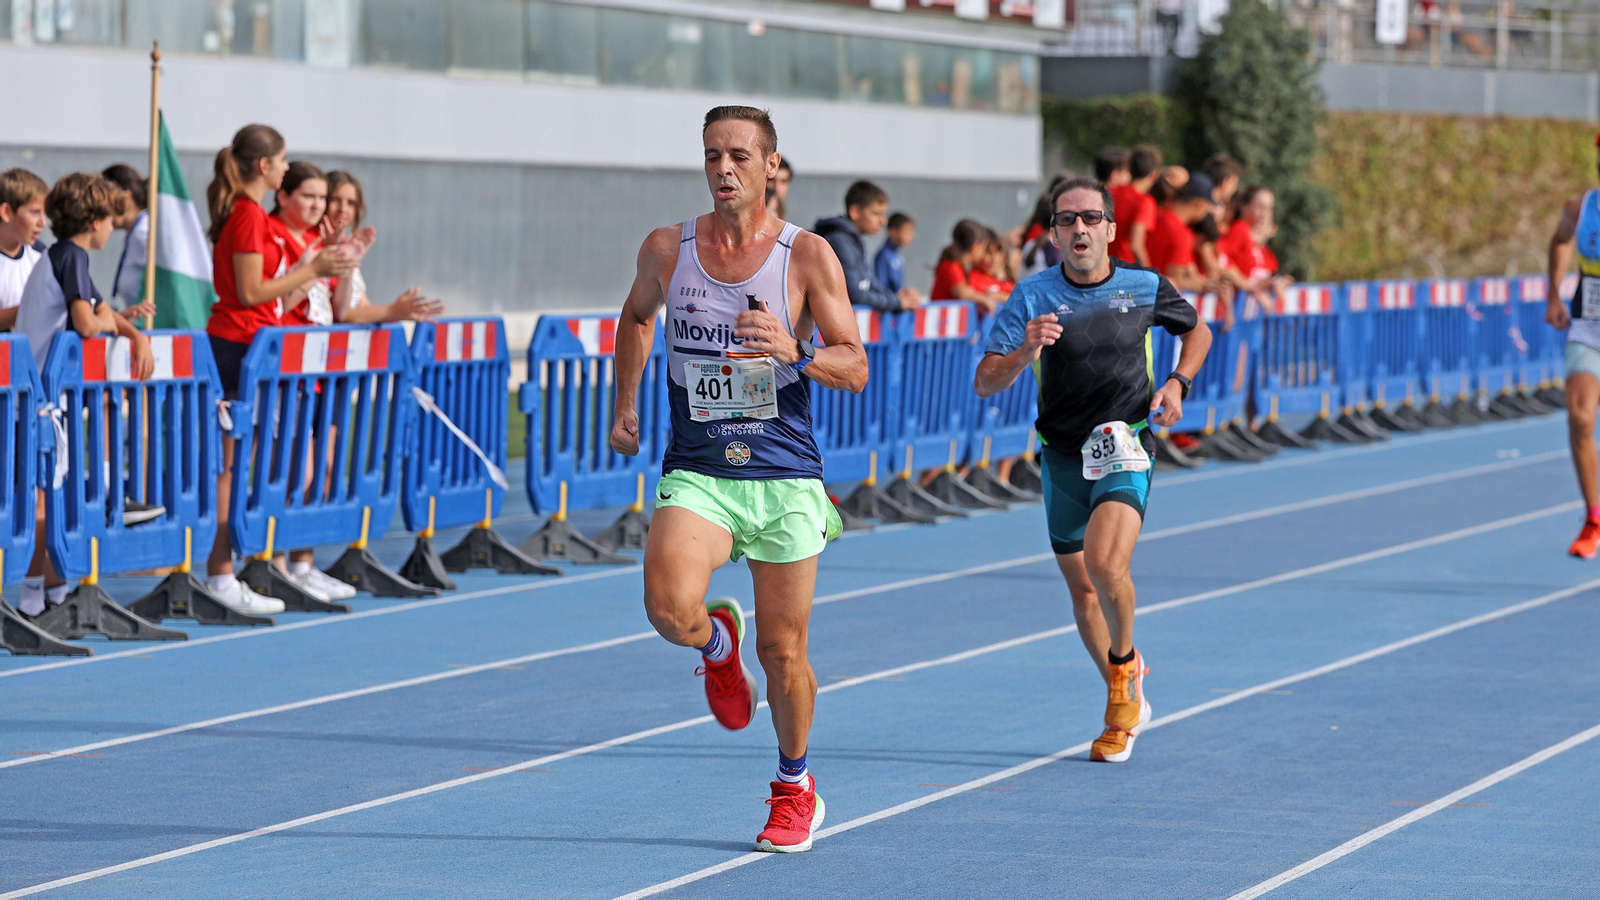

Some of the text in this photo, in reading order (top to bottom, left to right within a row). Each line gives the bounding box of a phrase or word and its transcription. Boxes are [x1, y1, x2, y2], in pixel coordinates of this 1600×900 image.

[680, 287, 707, 298] GOBIK
[695, 378, 733, 400] 401
[1091, 435, 1115, 459] 853
